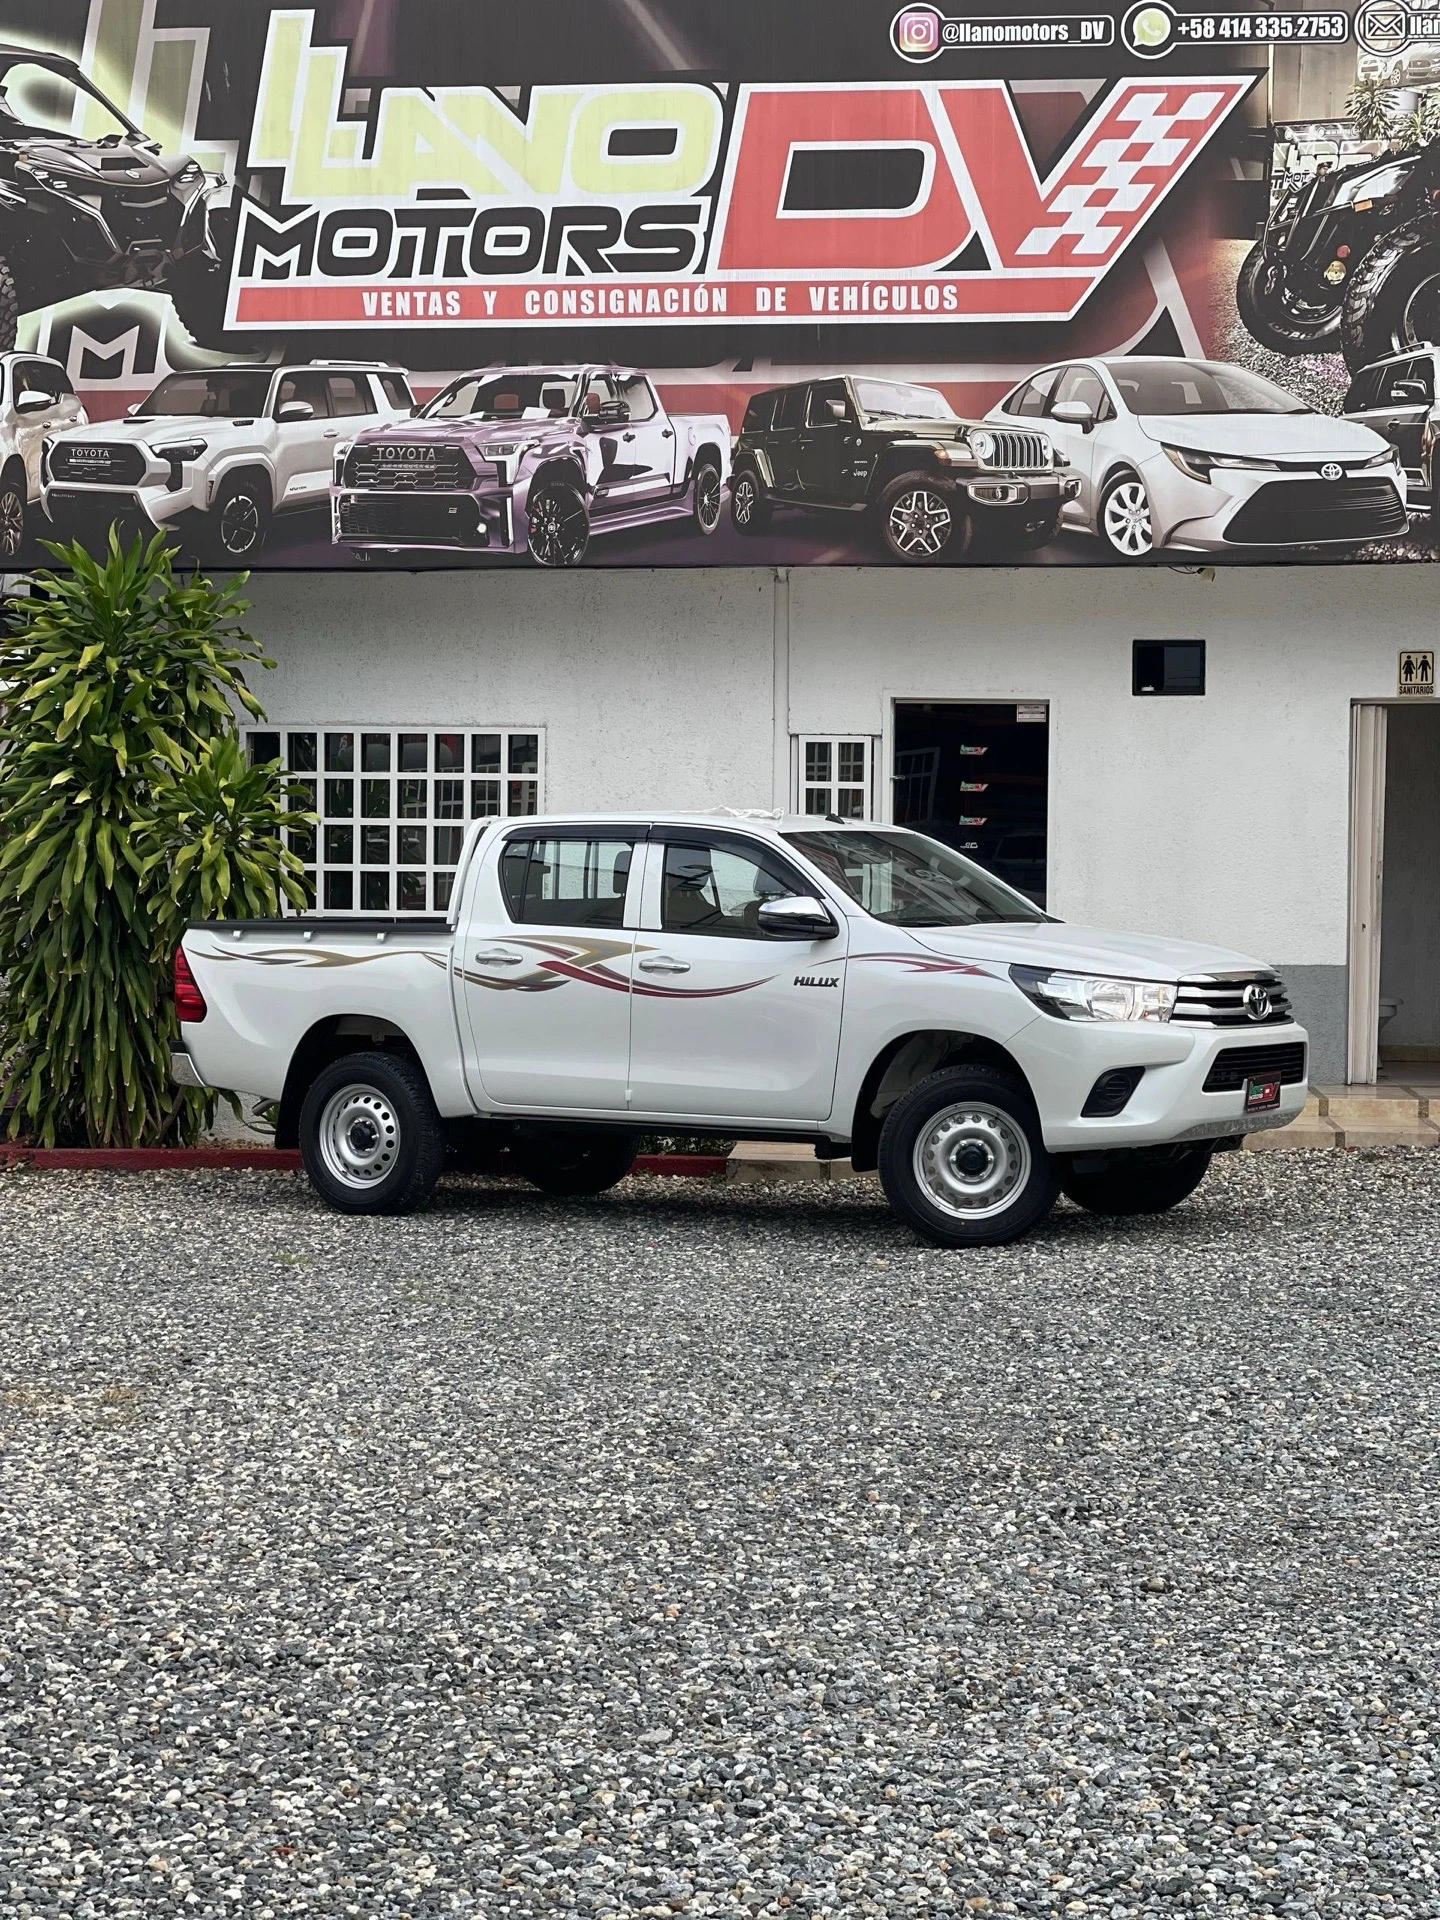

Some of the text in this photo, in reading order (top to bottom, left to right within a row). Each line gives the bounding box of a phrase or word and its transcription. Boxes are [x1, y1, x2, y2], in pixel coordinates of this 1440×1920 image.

[942, 20, 1105, 43] @llanomotors_DV
[1177, 16, 1343, 39] +58 414 335 2753
[254, 14, 717, 200] LLANO
[716, 82, 1246, 271] DV
[238, 204, 704, 281] MOTORS
[362, 281, 959, 316] VENTAS Y CONSIGNACIÓN DE VEHÍCULOS
[71, 448, 110, 458] TOYOTA
[376, 447, 436, 461] TOYOTA
[1398, 685, 1434, 695] SANITARIOS
[793, 976, 840, 988] HILUX
